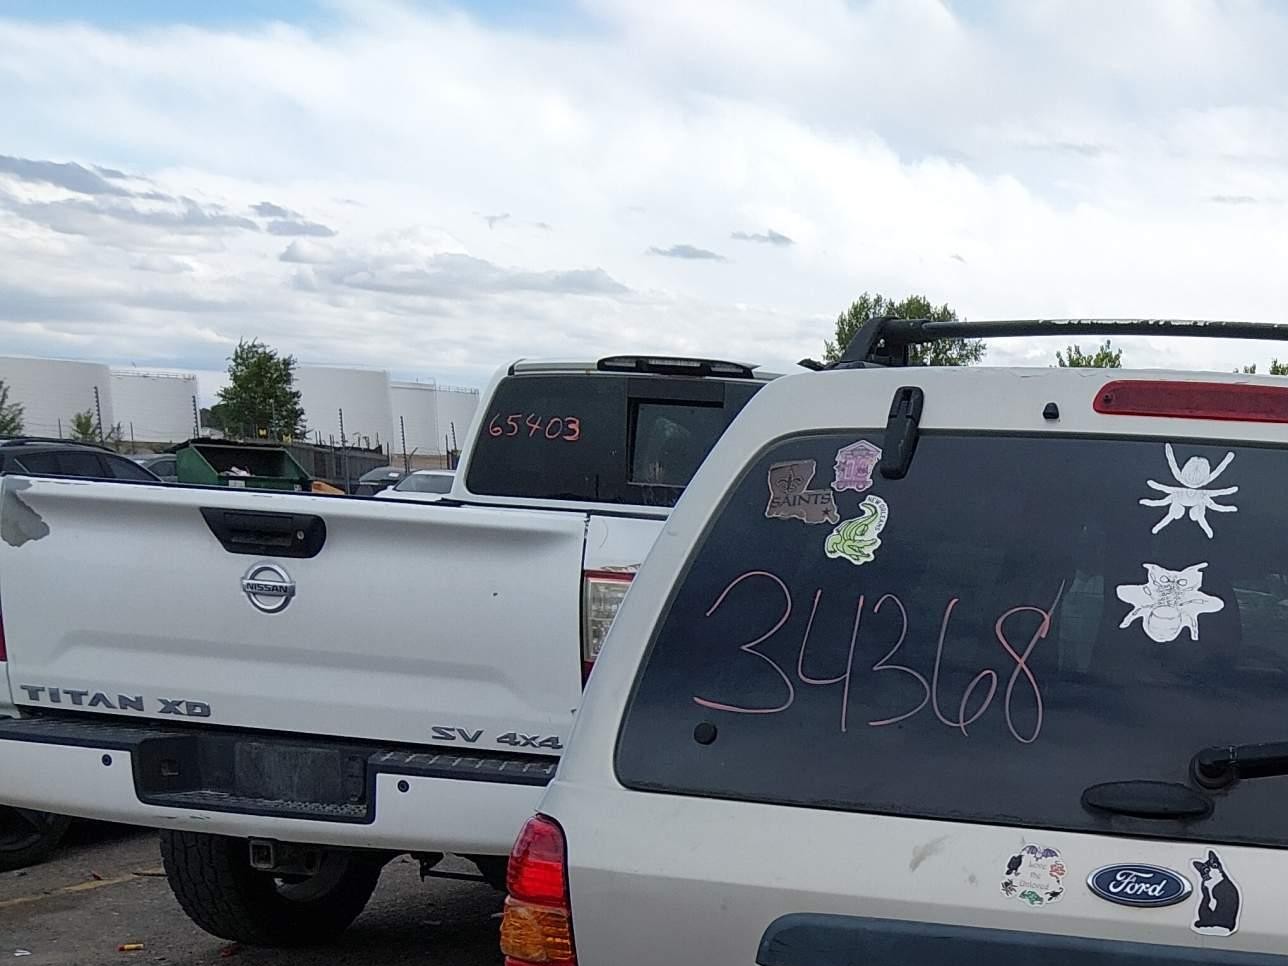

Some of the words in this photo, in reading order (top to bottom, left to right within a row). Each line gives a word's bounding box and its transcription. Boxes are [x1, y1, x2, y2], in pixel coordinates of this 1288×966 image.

[489, 413, 580, 441] 65403
[771, 494, 831, 508] SAINTS
[246, 583, 288, 593] NISSAN
[693, 571, 1065, 744] 34368
[20, 685, 144, 711] TITAN
[157, 697, 211, 718] XD
[432, 726, 485, 743] SV
[1108, 869, 1167, 898] Ford
